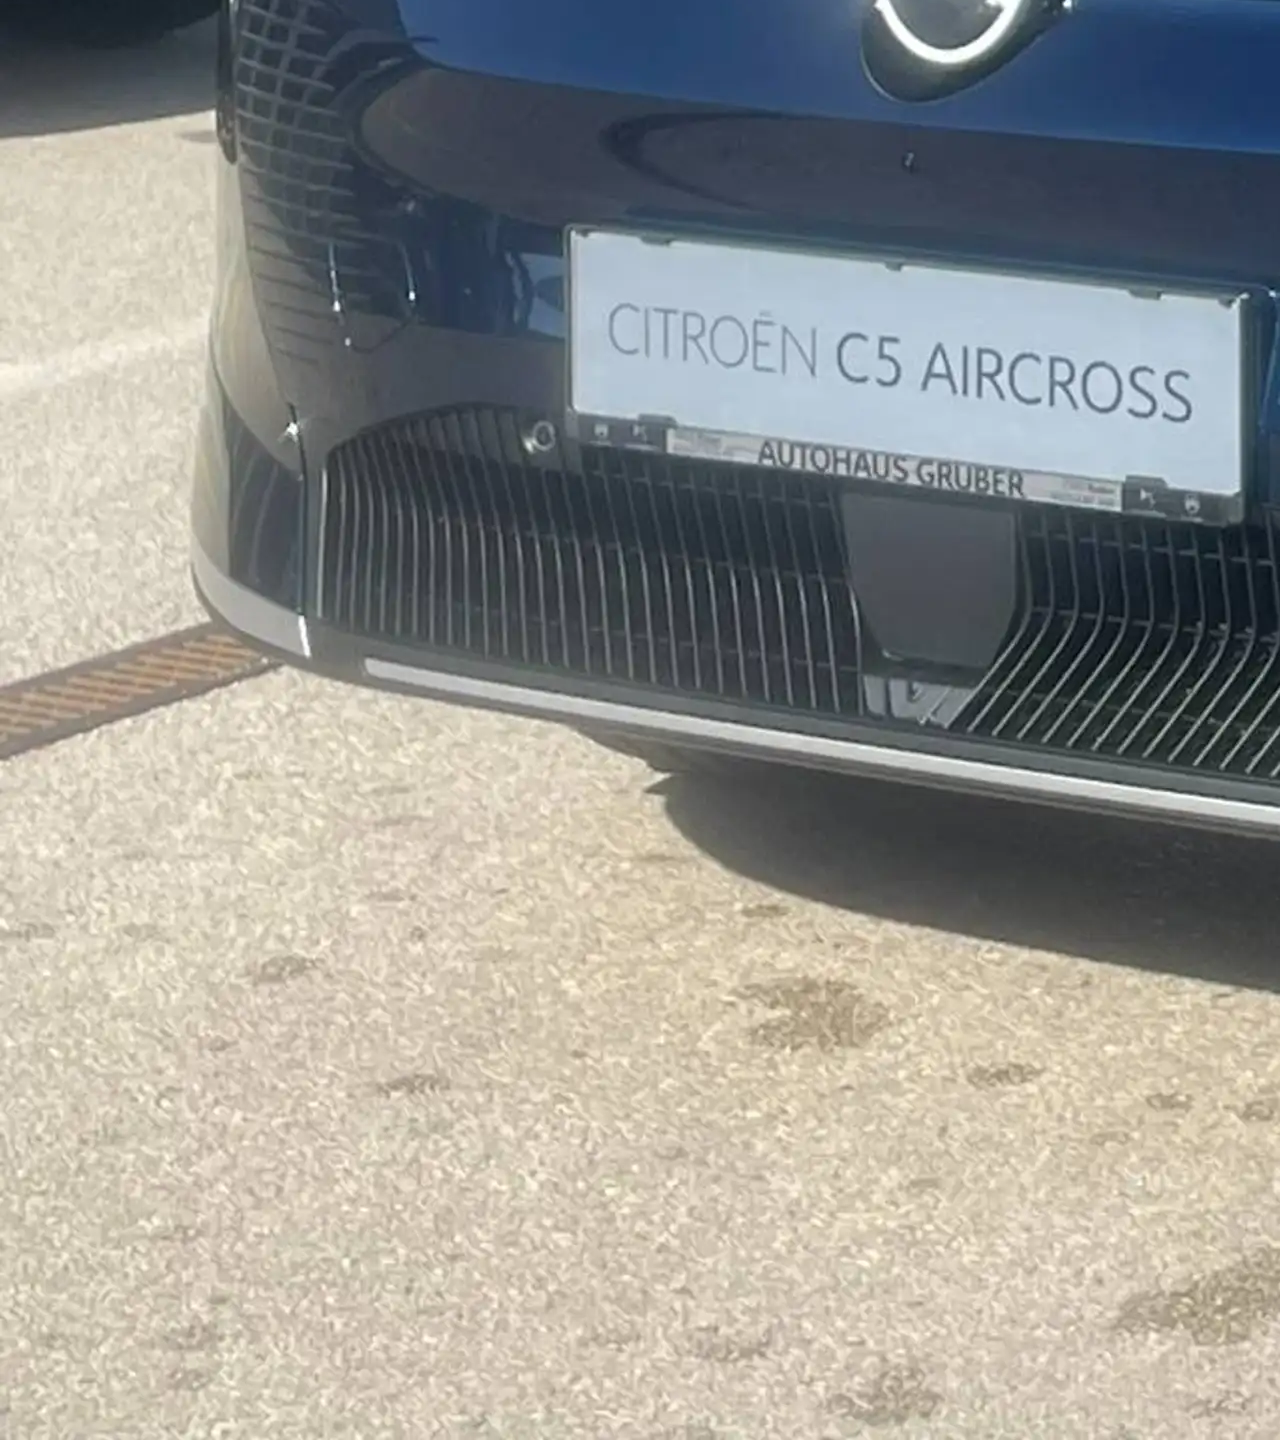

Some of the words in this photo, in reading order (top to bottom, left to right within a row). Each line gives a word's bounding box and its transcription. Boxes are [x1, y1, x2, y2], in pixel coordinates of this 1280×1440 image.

[608, 302, 818, 378] CITROËN
[836, 331, 902, 387] C5
[920, 341, 1193, 423] AIRCROSS
[757, 439, 909, 482] AUTOHAUS
[916, 458, 1026, 497] GRUBER
